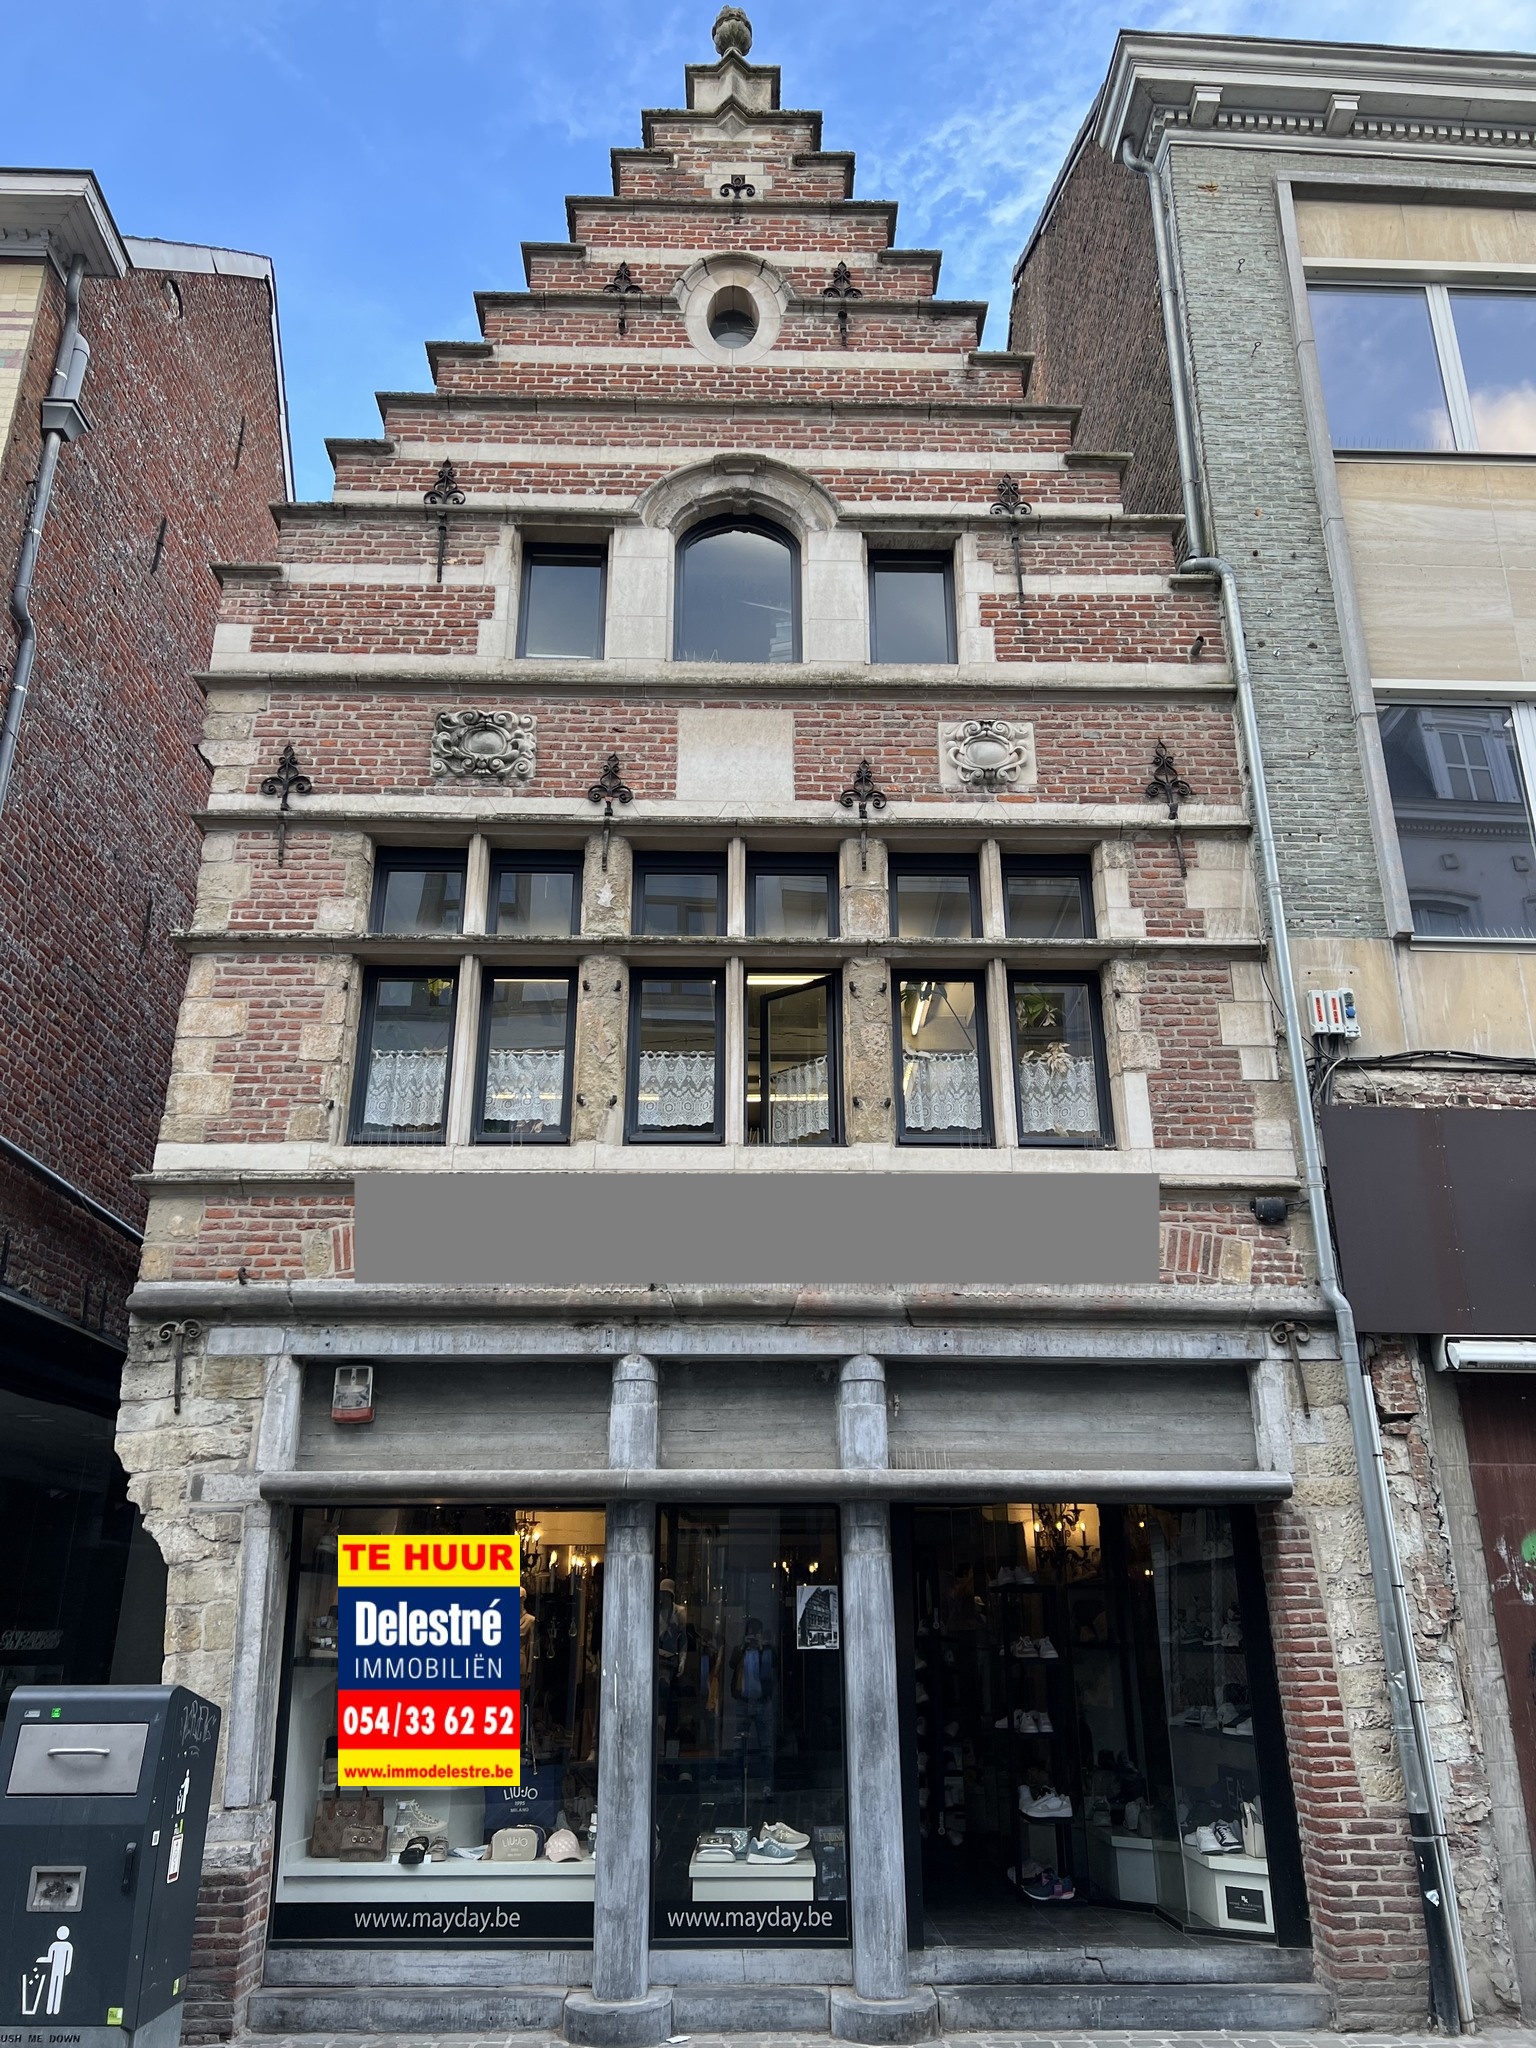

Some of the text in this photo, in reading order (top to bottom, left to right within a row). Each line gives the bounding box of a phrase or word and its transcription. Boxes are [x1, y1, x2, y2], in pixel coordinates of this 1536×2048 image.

[354, 1906, 521, 1933] www.mayday.be
[667, 1905, 833, 1933] www.mayday.be
[0, 2034, 80, 2043] USH ME DOWN
